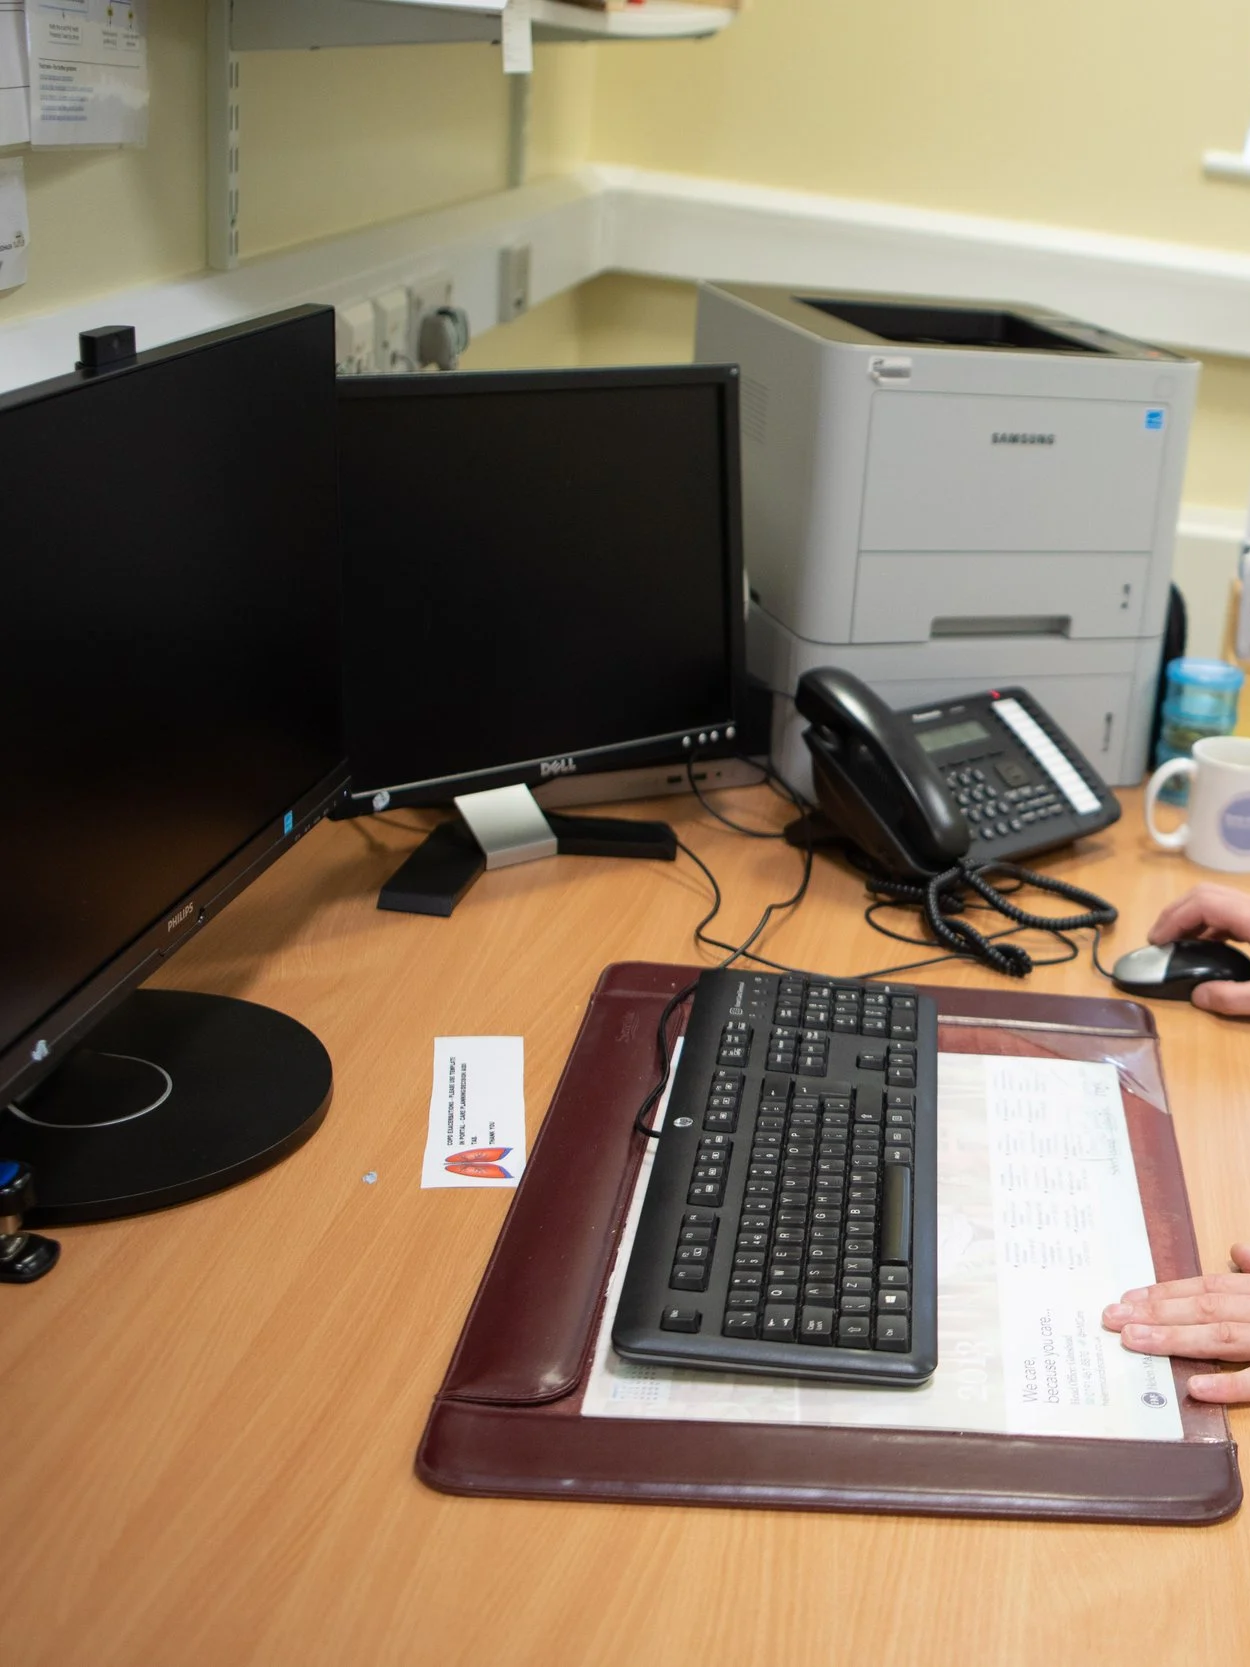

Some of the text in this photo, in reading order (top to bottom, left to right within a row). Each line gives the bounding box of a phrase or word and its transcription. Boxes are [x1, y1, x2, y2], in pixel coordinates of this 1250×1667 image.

[992, 433, 1055, 445] SAMSUNG
[540, 757, 577, 777] DELL
[167, 902, 194, 932] PHILIPS
[815, 1212, 826, 1220] G
[812, 1249, 824, 1257] D
[1039, 1309, 1059, 1404] because you care...
[1023, 1357, 1038, 1403] We care,
[1068, 1387, 1080, 1404] Head
